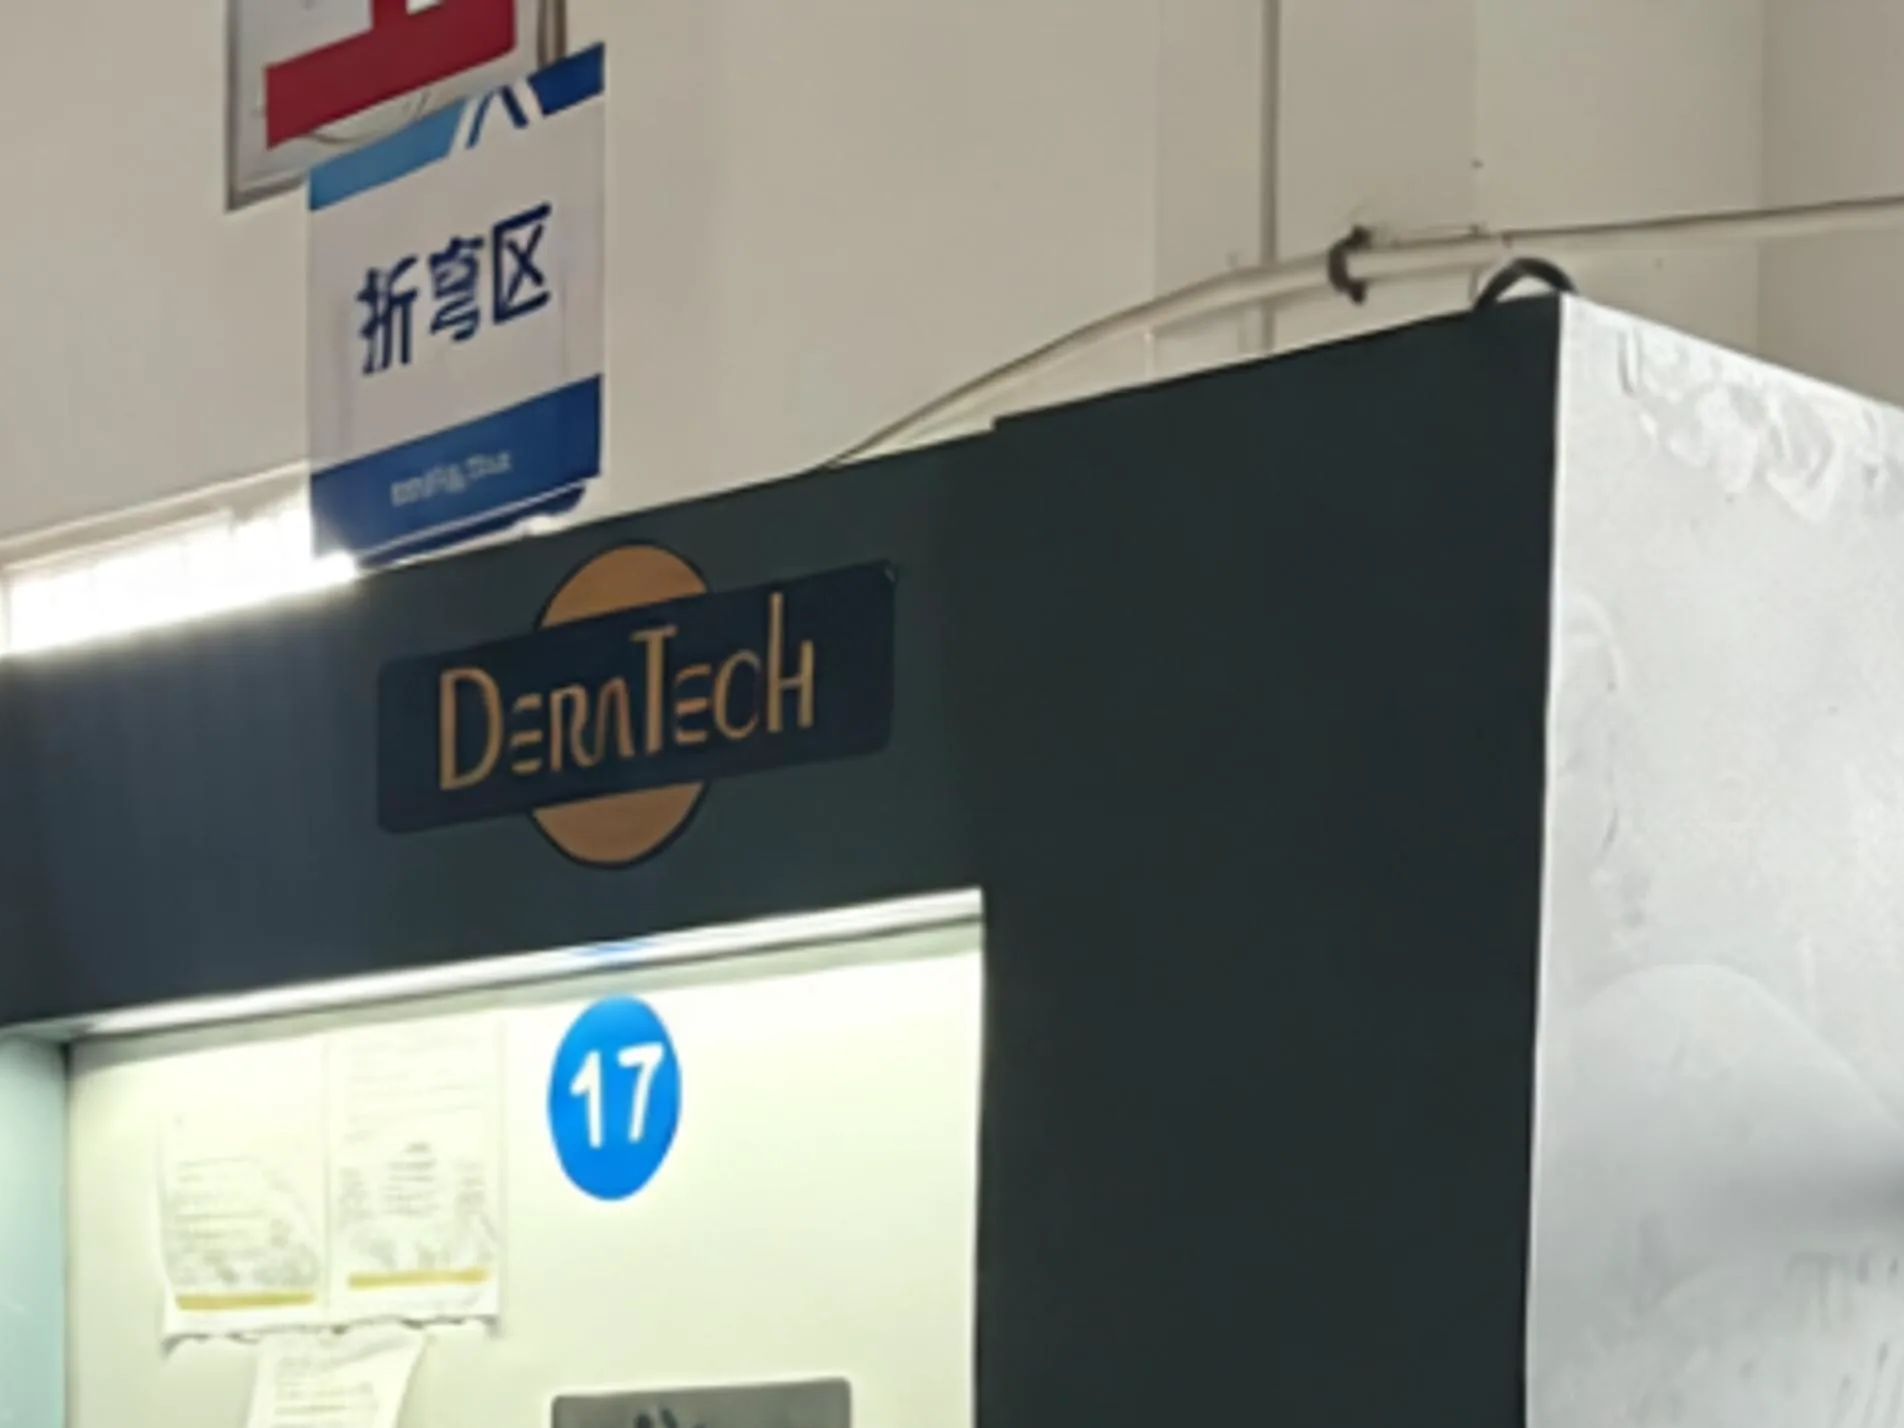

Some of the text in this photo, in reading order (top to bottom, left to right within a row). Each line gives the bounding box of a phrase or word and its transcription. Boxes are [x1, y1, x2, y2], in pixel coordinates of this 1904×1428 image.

[355, 202, 554, 376] 折弯区
[569, 1040, 665, 1150] 17
